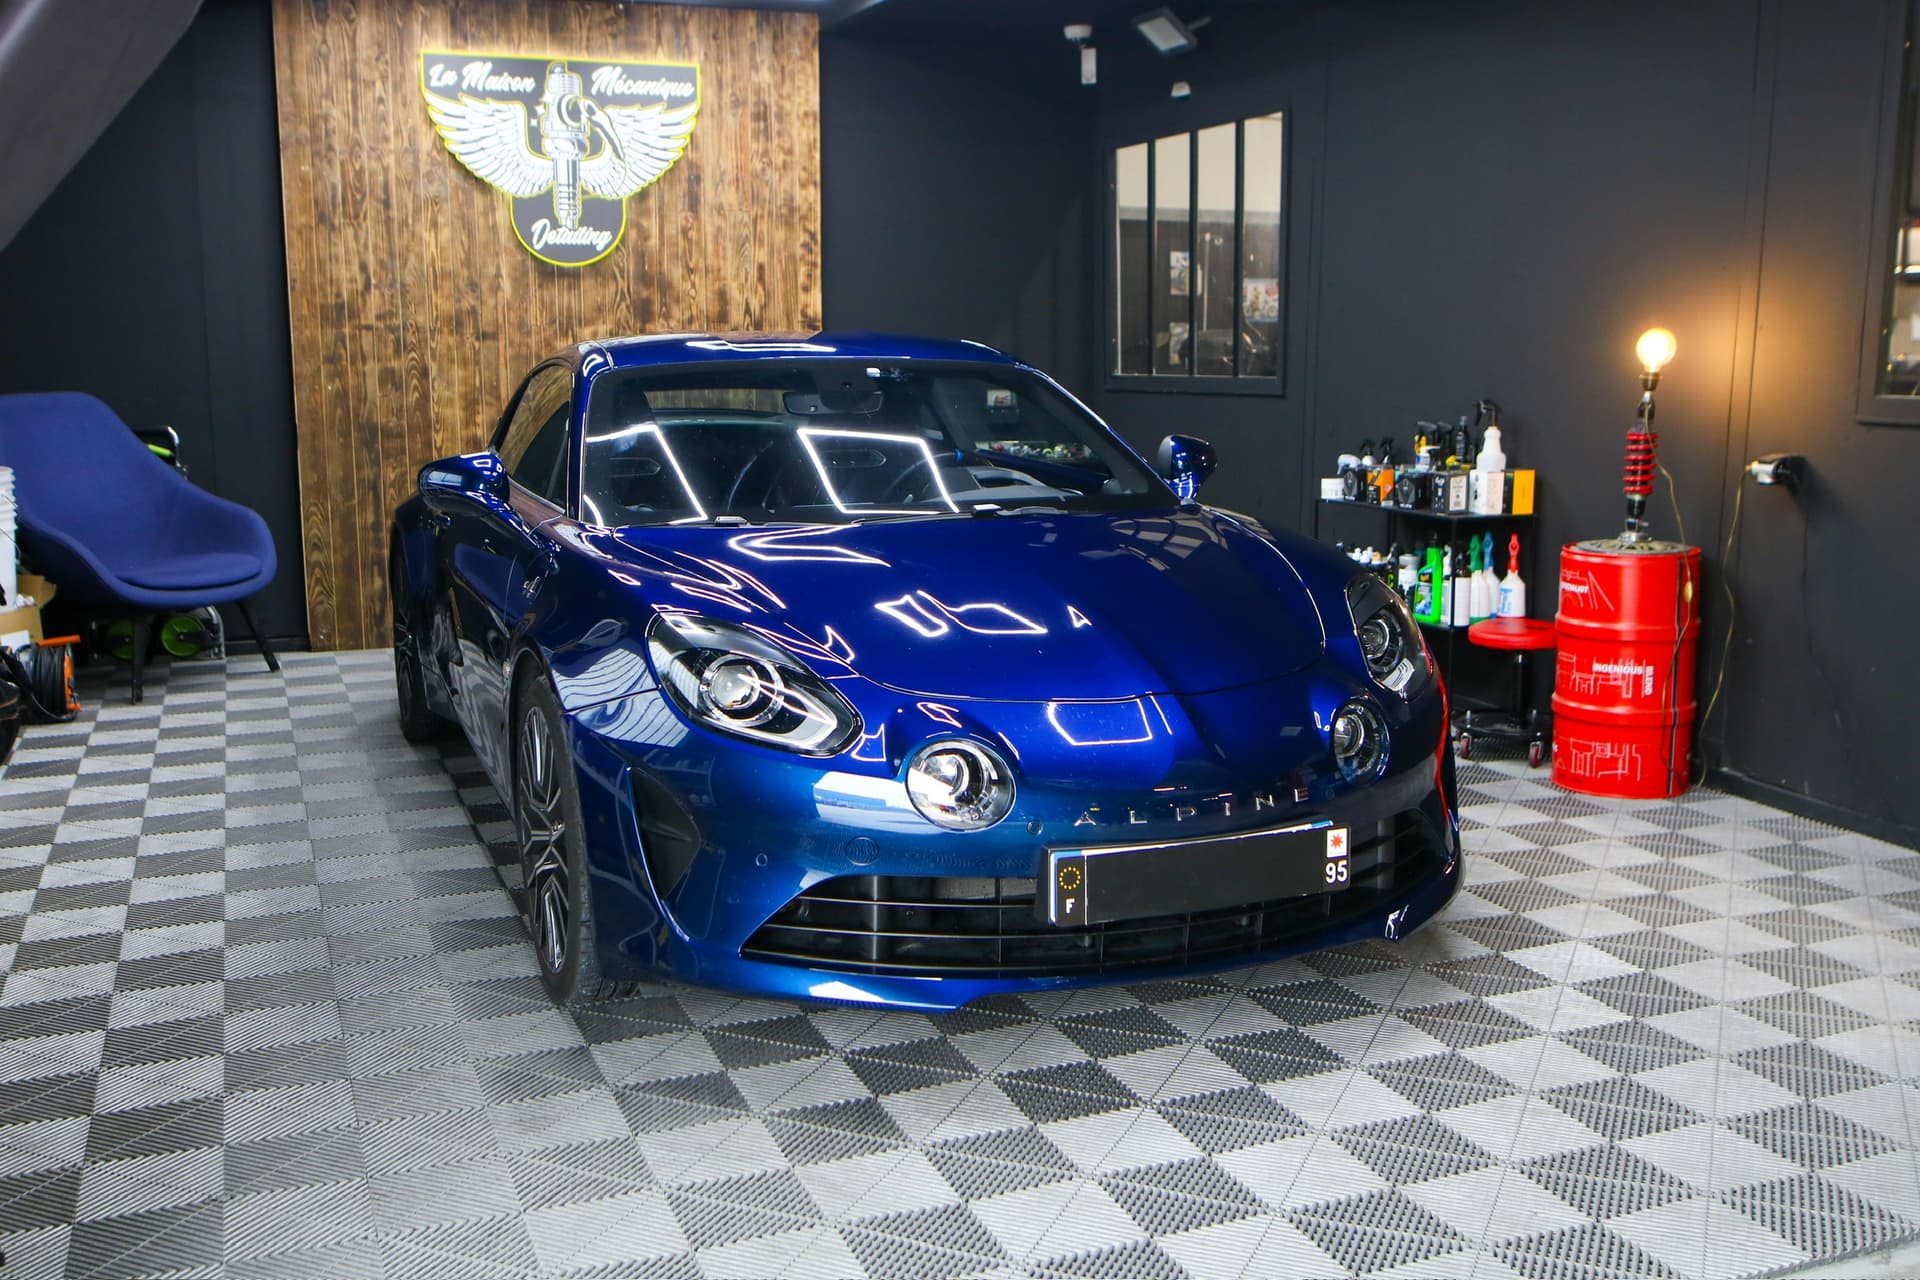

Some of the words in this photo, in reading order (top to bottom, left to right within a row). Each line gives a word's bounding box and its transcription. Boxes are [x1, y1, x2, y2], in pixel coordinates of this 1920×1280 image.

[429, 63, 458, 87] La
[462, 61, 536, 93] Maison
[591, 65, 695, 101] Mécanique
[531, 218, 613, 252] Detailing
[1073, 787, 1309, 827] ALPINE
[1325, 859, 1348, 884] 95
[1065, 898, 1075, 914] F
